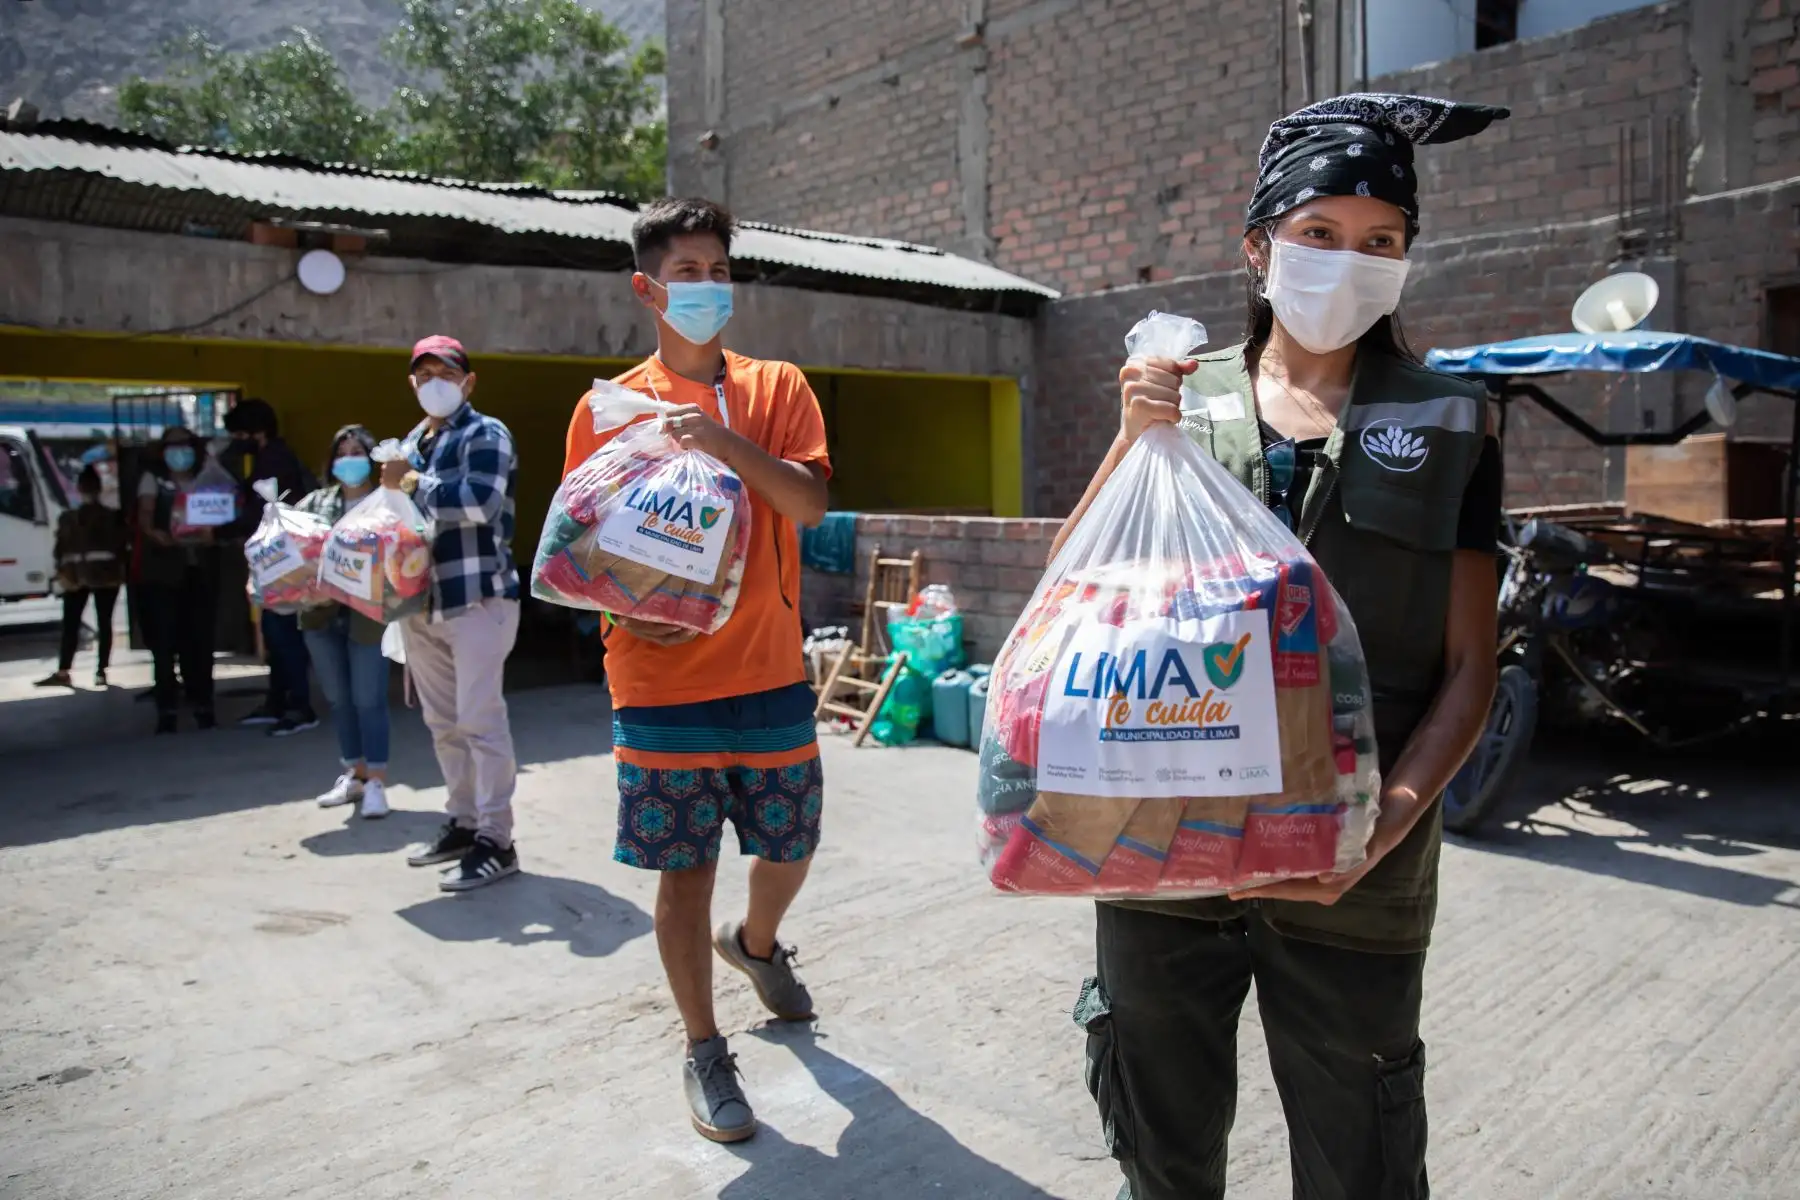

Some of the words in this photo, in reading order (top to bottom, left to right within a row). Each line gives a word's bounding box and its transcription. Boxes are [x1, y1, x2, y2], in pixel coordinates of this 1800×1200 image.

[625, 487, 693, 530] LIMA
[664, 523, 705, 544] cuida
[1063, 648, 1201, 700] LIMA
[1145, 689, 1232, 729] cuida
[1115, 730, 1192, 742] MUNICIPALIDAD
[1193, 730, 1208, 740] DE
[1210, 729, 1236, 739] LIMA
[1256, 818, 1317, 839] Spaghetti
[1027, 840, 1077, 880] Spaghetti
